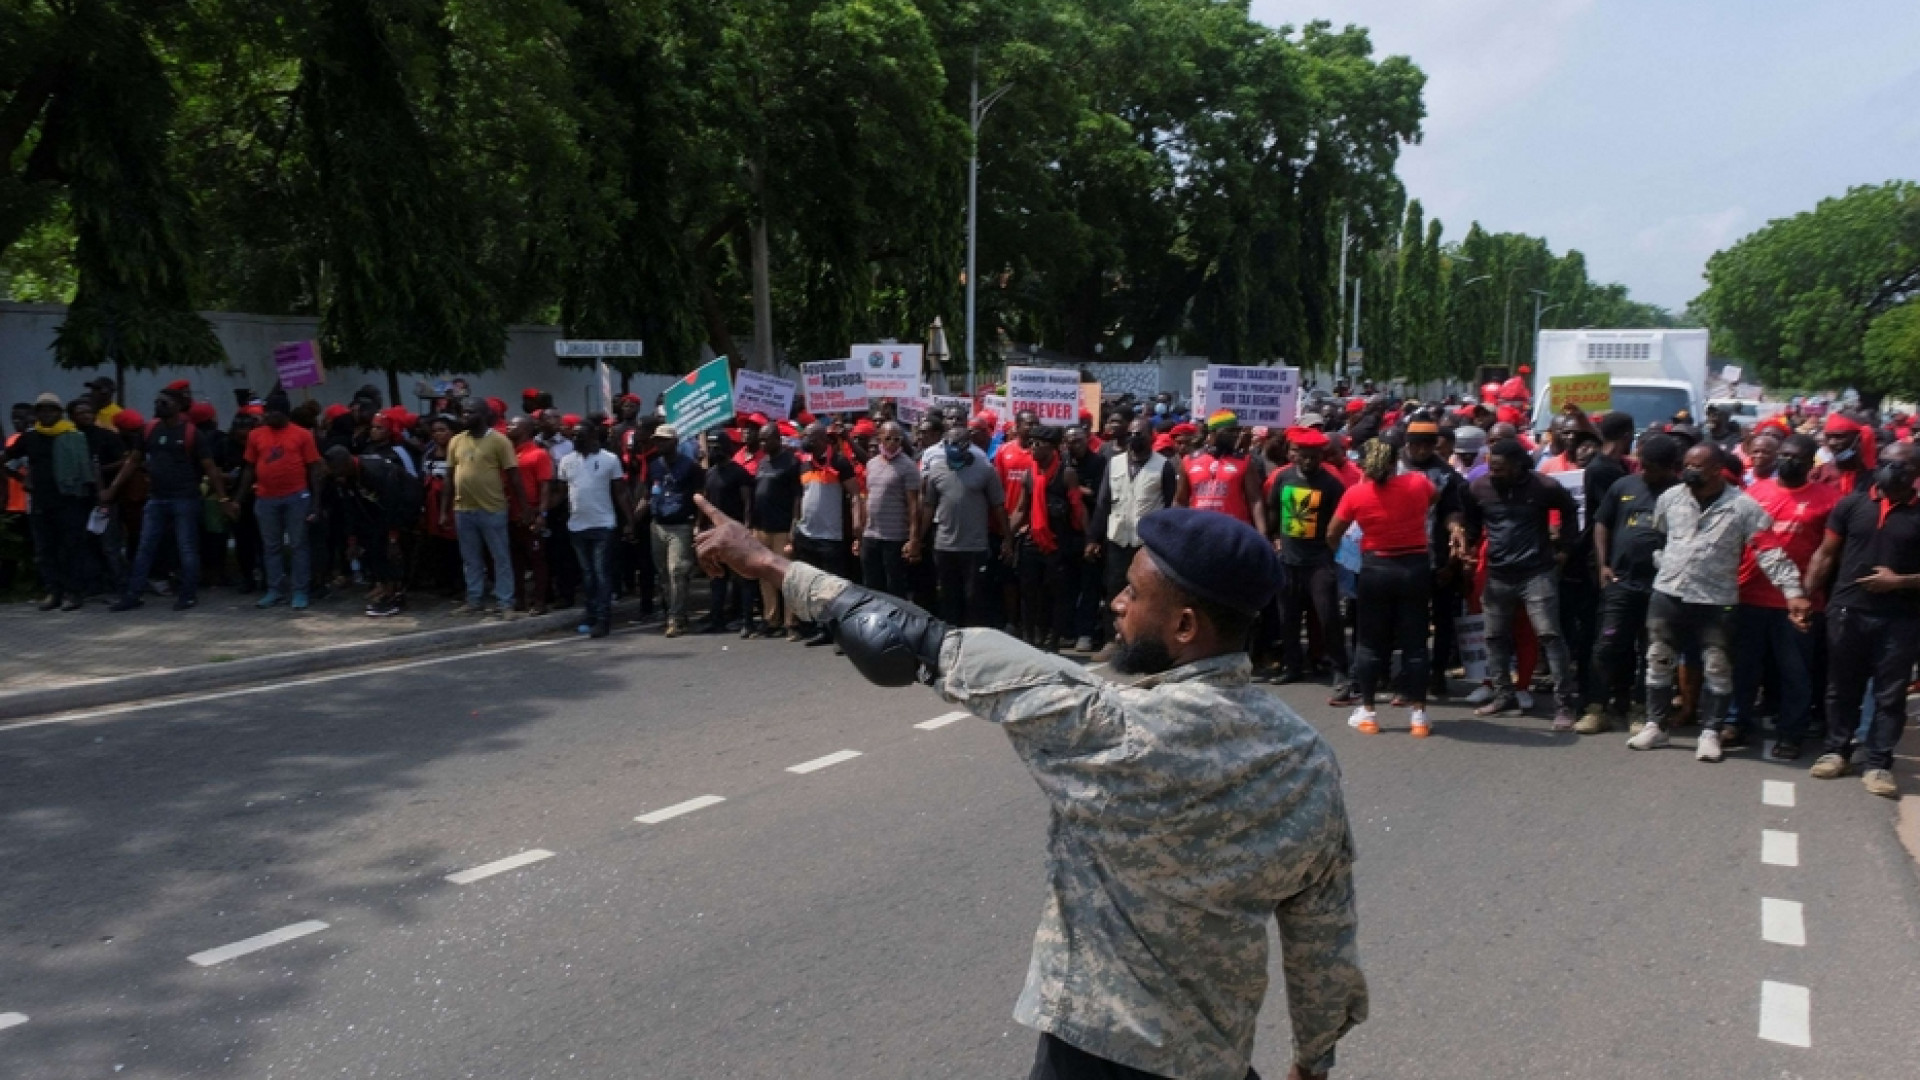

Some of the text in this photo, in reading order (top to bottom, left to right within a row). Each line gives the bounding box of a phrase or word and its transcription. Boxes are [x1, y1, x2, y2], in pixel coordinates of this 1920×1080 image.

[1219, 368, 1244, 379] DOUBLE
[1247, 370, 1279, 380] TAXATION
[1012, 387, 1077, 400] Demolished
[1221, 393, 1236, 404] OUR
[1239, 394, 1250, 405] TAX
[1012, 401, 1072, 419] FOREVER
